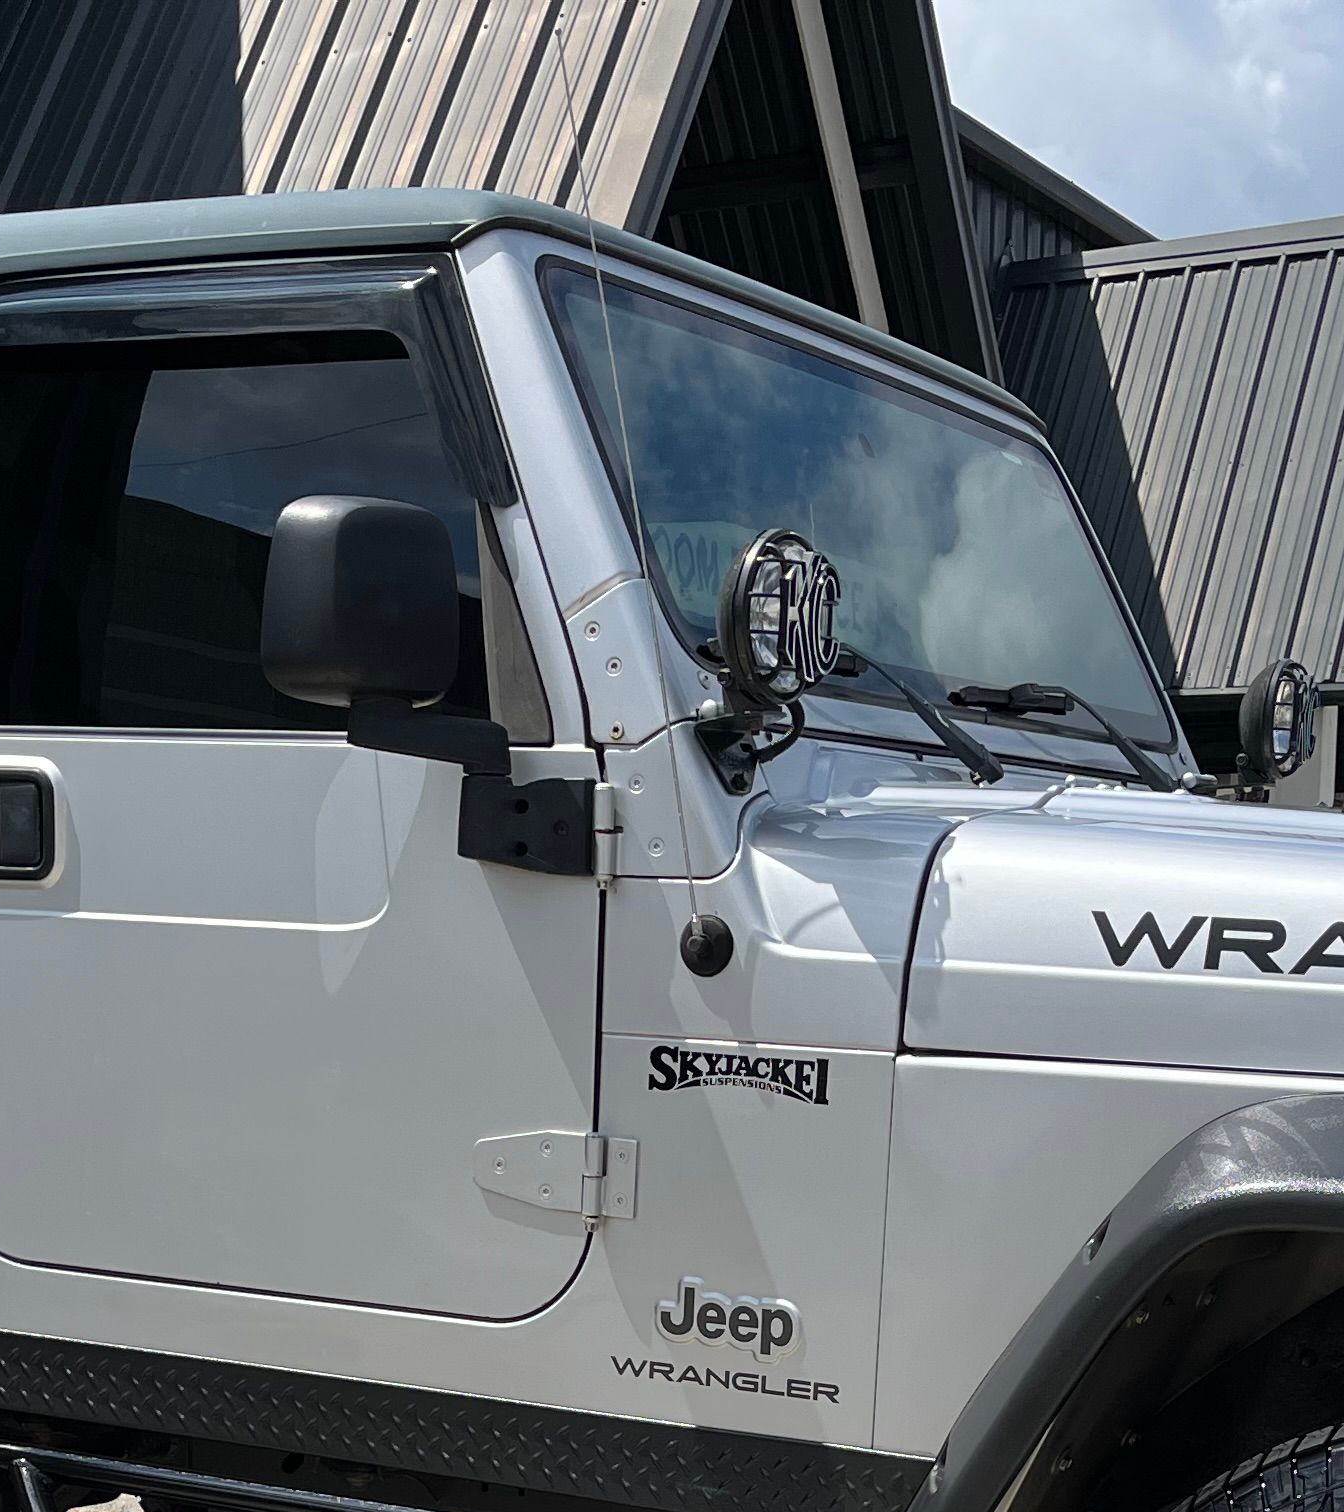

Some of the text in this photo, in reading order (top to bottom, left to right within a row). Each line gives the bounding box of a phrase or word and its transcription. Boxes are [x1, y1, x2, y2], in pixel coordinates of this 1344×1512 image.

[701, 1077, 783, 1094] SUSPENSIONS
[660, 1286, 794, 1355] Jeep
[610, 1355, 840, 1403] WRANGLER
